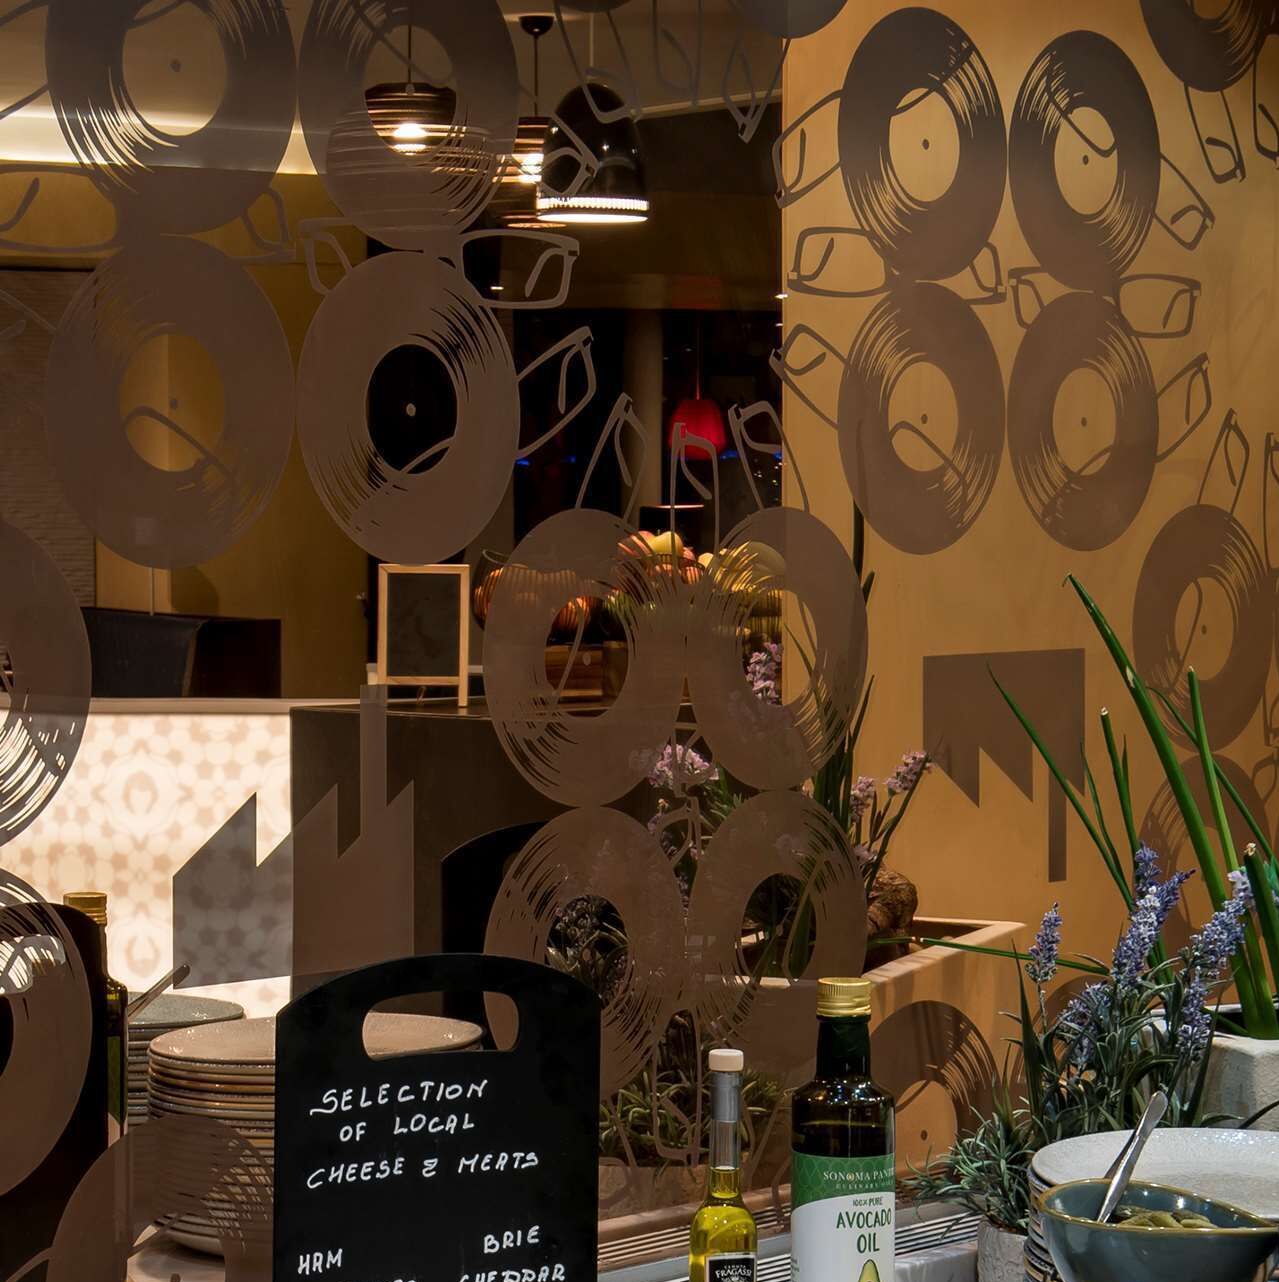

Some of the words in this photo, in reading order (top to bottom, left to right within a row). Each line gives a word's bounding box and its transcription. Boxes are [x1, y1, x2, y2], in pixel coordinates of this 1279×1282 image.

[310, 1079, 488, 1115] SELECTION
[339, 1122, 367, 1142] OF
[393, 1113, 475, 1135] LOCAL
[306, 1157, 405, 1189] CHEESE
[458, 1152, 539, 1174] MEATS
[823, 1171, 871, 1181] SONOMA
[868, 1196, 883, 1207] PURE
[836, 1208, 892, 1229] AVOCADO
[483, 1225, 540, 1254] BRIE
[857, 1232, 880, 1254] OIL
[297, 1248, 343, 1275] HAM
